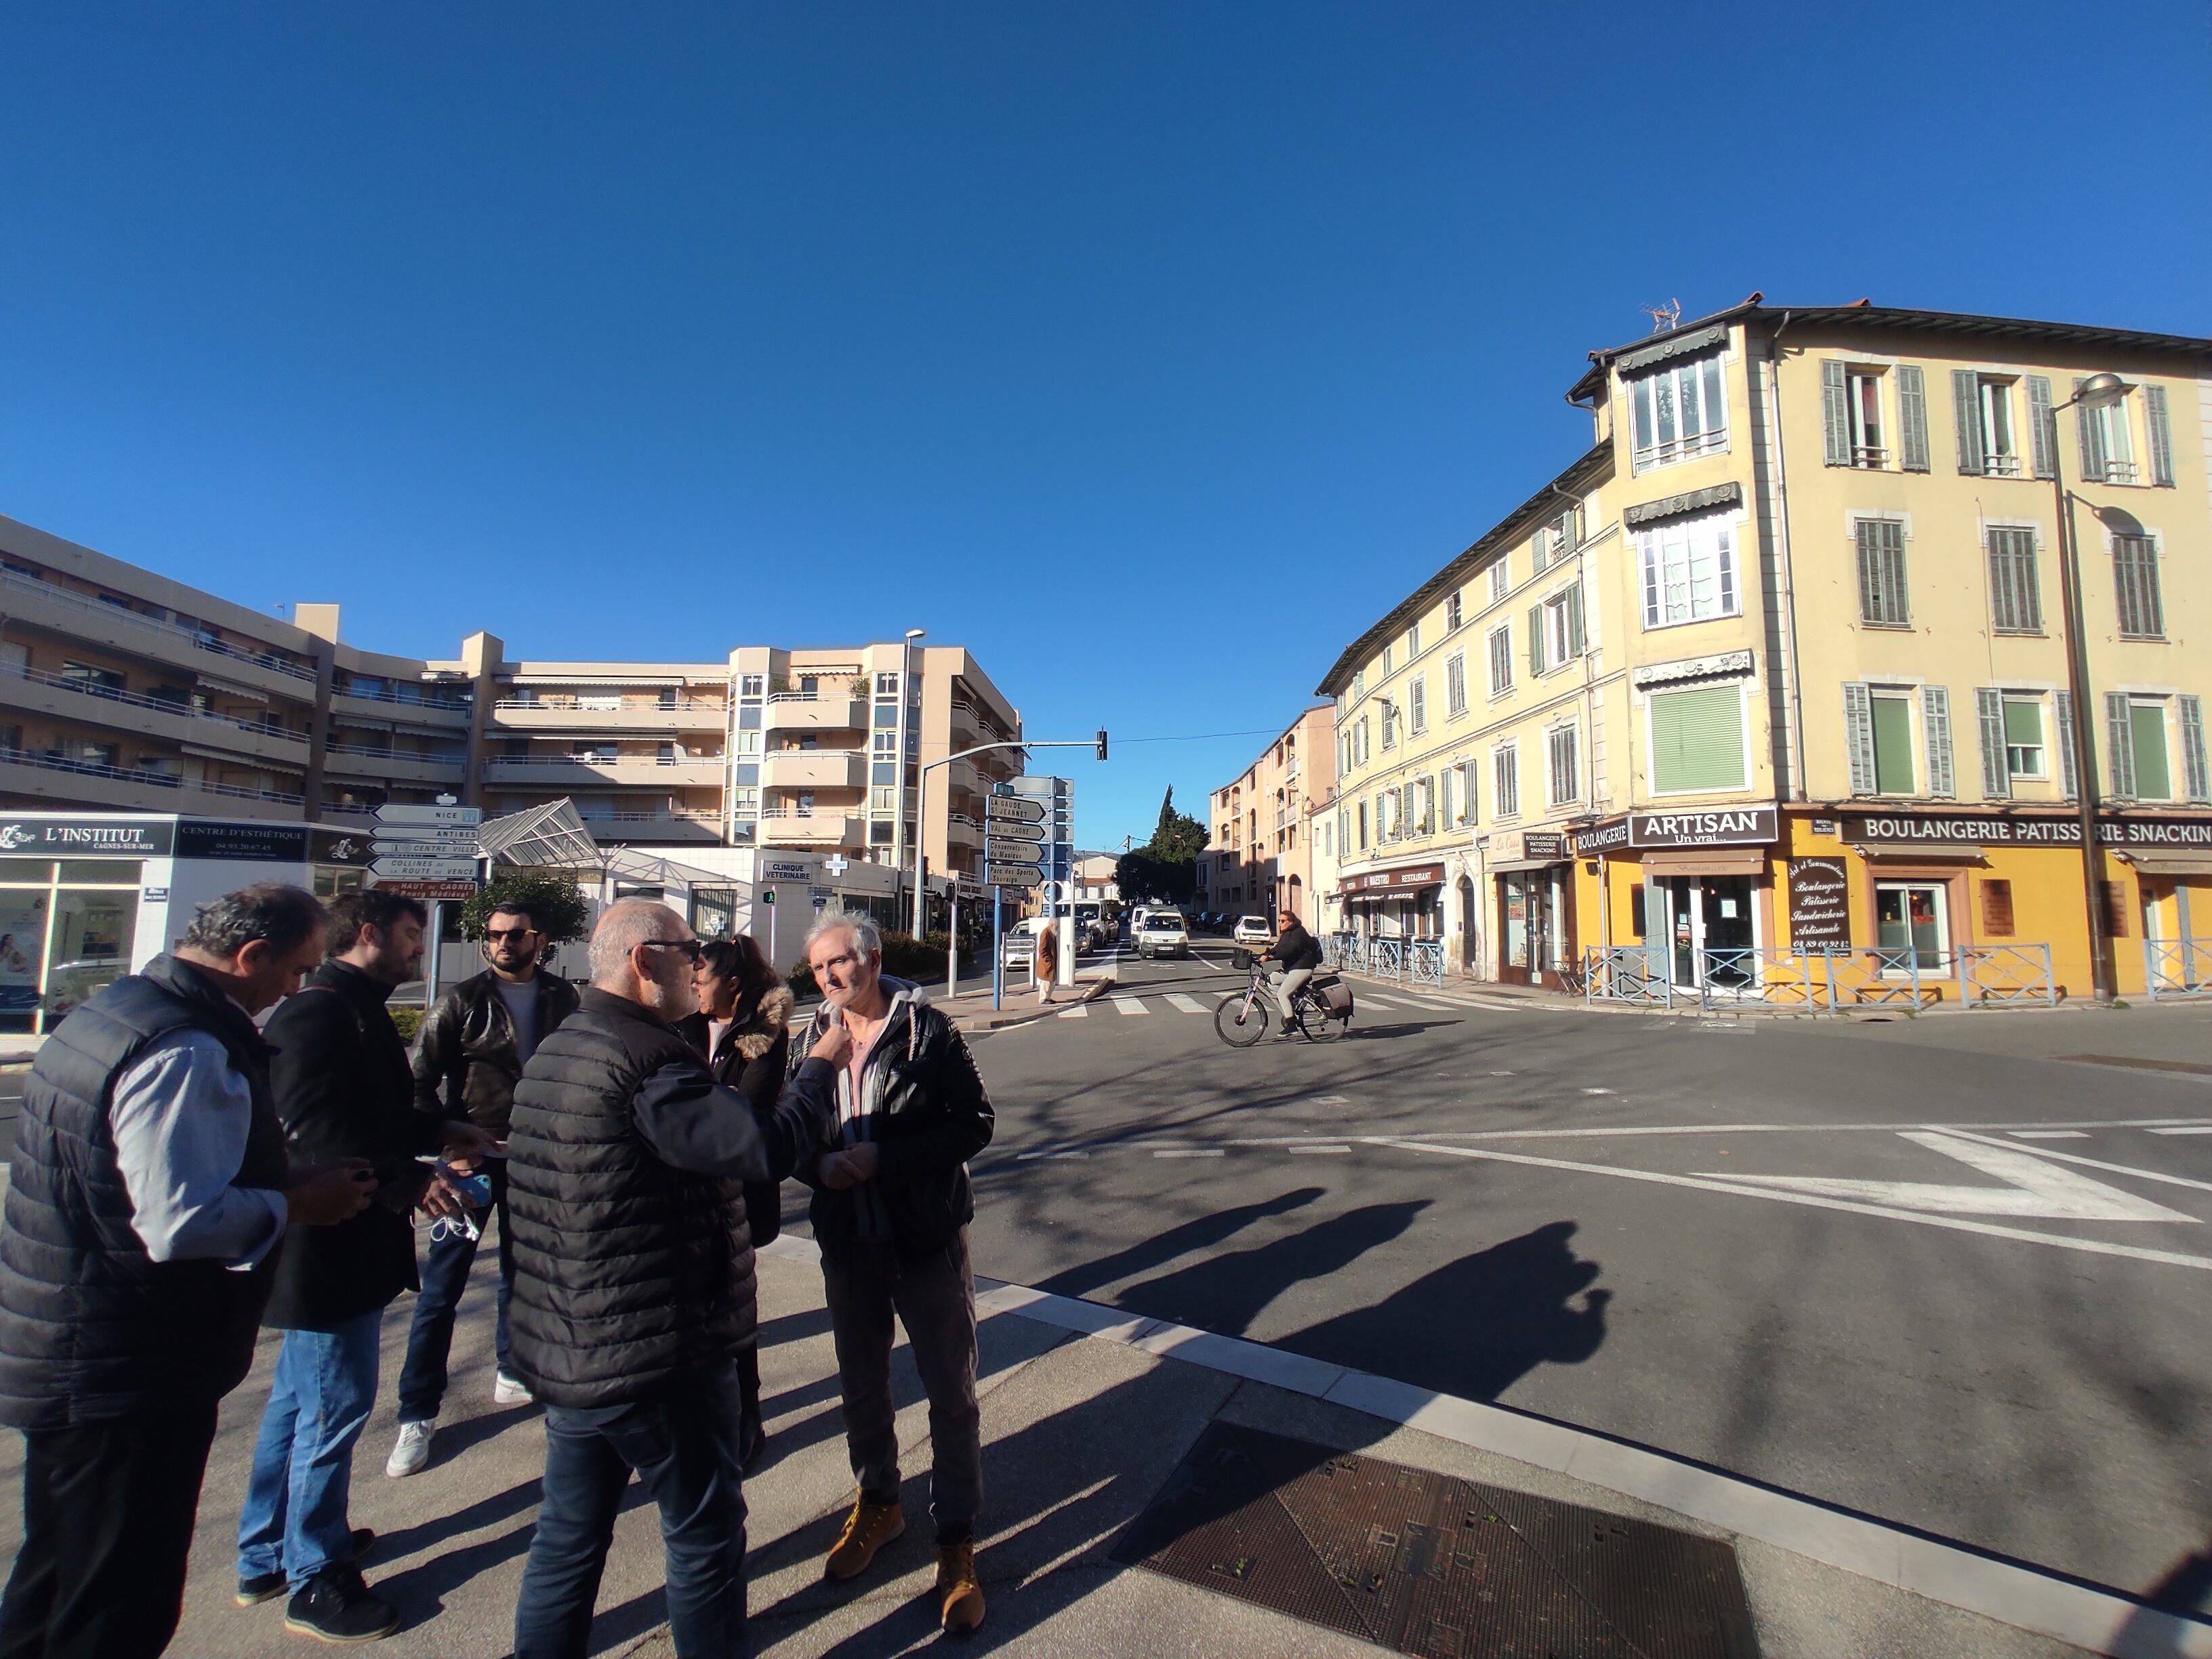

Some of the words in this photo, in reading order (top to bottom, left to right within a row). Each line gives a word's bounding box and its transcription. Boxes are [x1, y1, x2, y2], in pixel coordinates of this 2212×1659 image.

[1000, 801, 1021, 809] GAUDE
[1000, 809, 1027, 817] JEANNET
[1644, 812, 1758, 835] ARTISAN
[45, 827, 145, 842] L'INSTITUT
[182, 827, 227, 836] CENTRE
[1866, 819, 2010, 840] BOULANGERIE
[2015, 823, 2124, 842] PATISSRIE
[1578, 825, 1626, 850] BOULANGERIE
[1675, 834, 1692, 843] Un
[1694, 833, 1726, 842] vrai...
[990, 842, 1028, 852] Conservatoire
[1000, 851, 1022, 859] Musique
[773, 863, 804, 872] CLINIQUE
[766, 872, 811, 880] VETERINAIRE
[1017, 869, 1033, 878] Sports
[1401, 872, 1432, 882] RESTAURANT
[1795, 881, 1846, 894] Boulangerie
[401, 890, 426, 899] Bourg
[1801, 895, 1840, 906] Pâtisserie
[1791, 909, 1846, 922] Sandwicherie
[1795, 923, 1841, 936] Artisanale
[1793, 940, 1804, 948] 04
